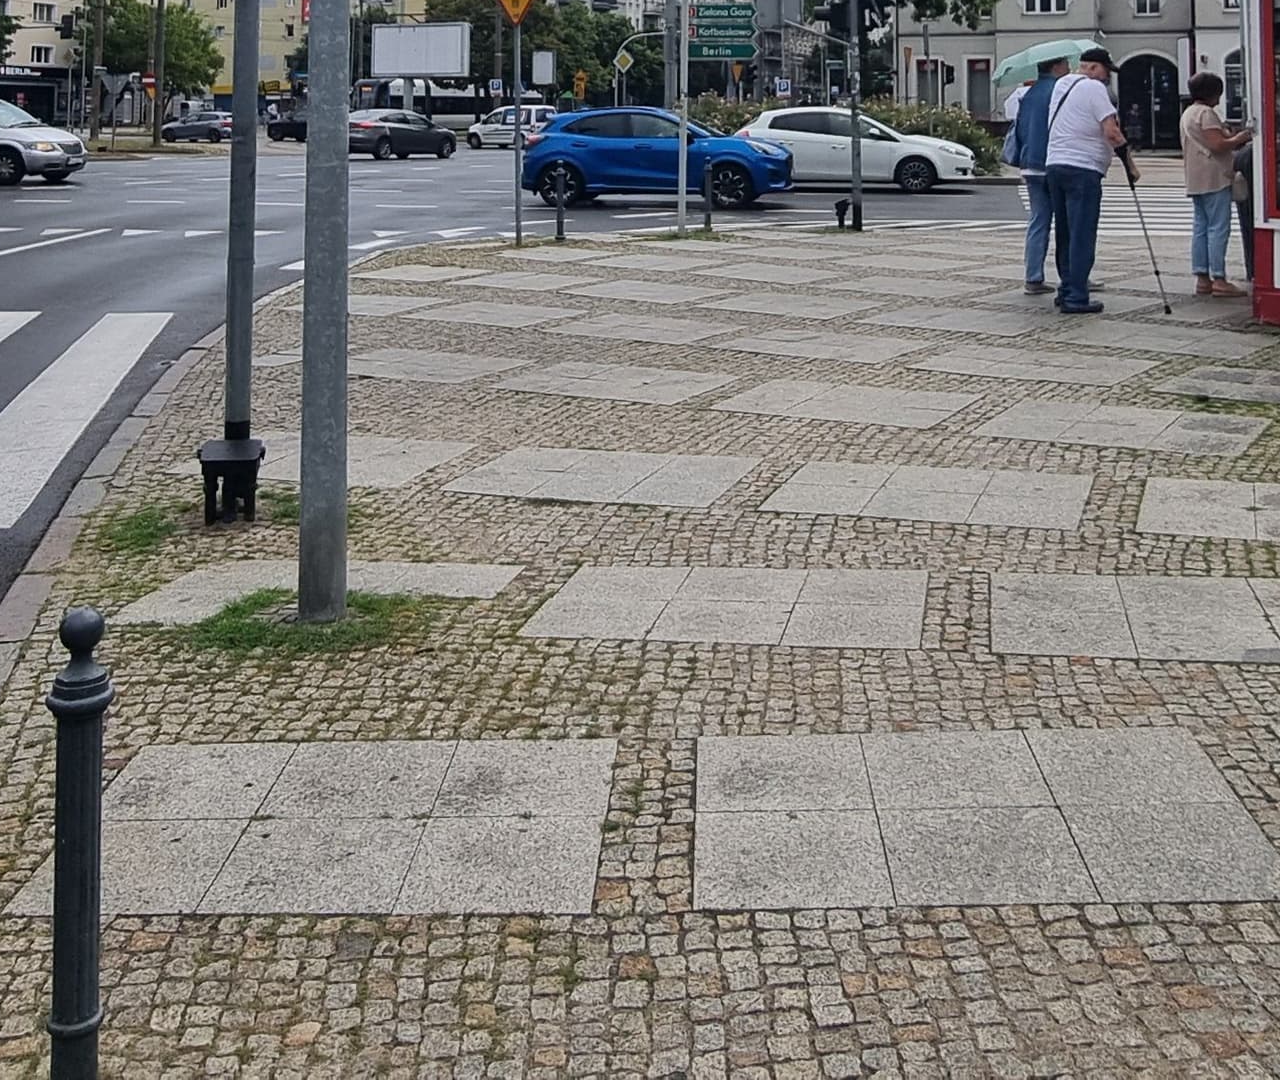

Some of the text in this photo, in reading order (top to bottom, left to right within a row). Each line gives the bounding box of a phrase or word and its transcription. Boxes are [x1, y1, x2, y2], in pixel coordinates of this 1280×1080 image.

[698, 6, 728, 17] Zielona
[729, 6, 753, 17] Góra
[702, 46, 732, 56] Berlin
